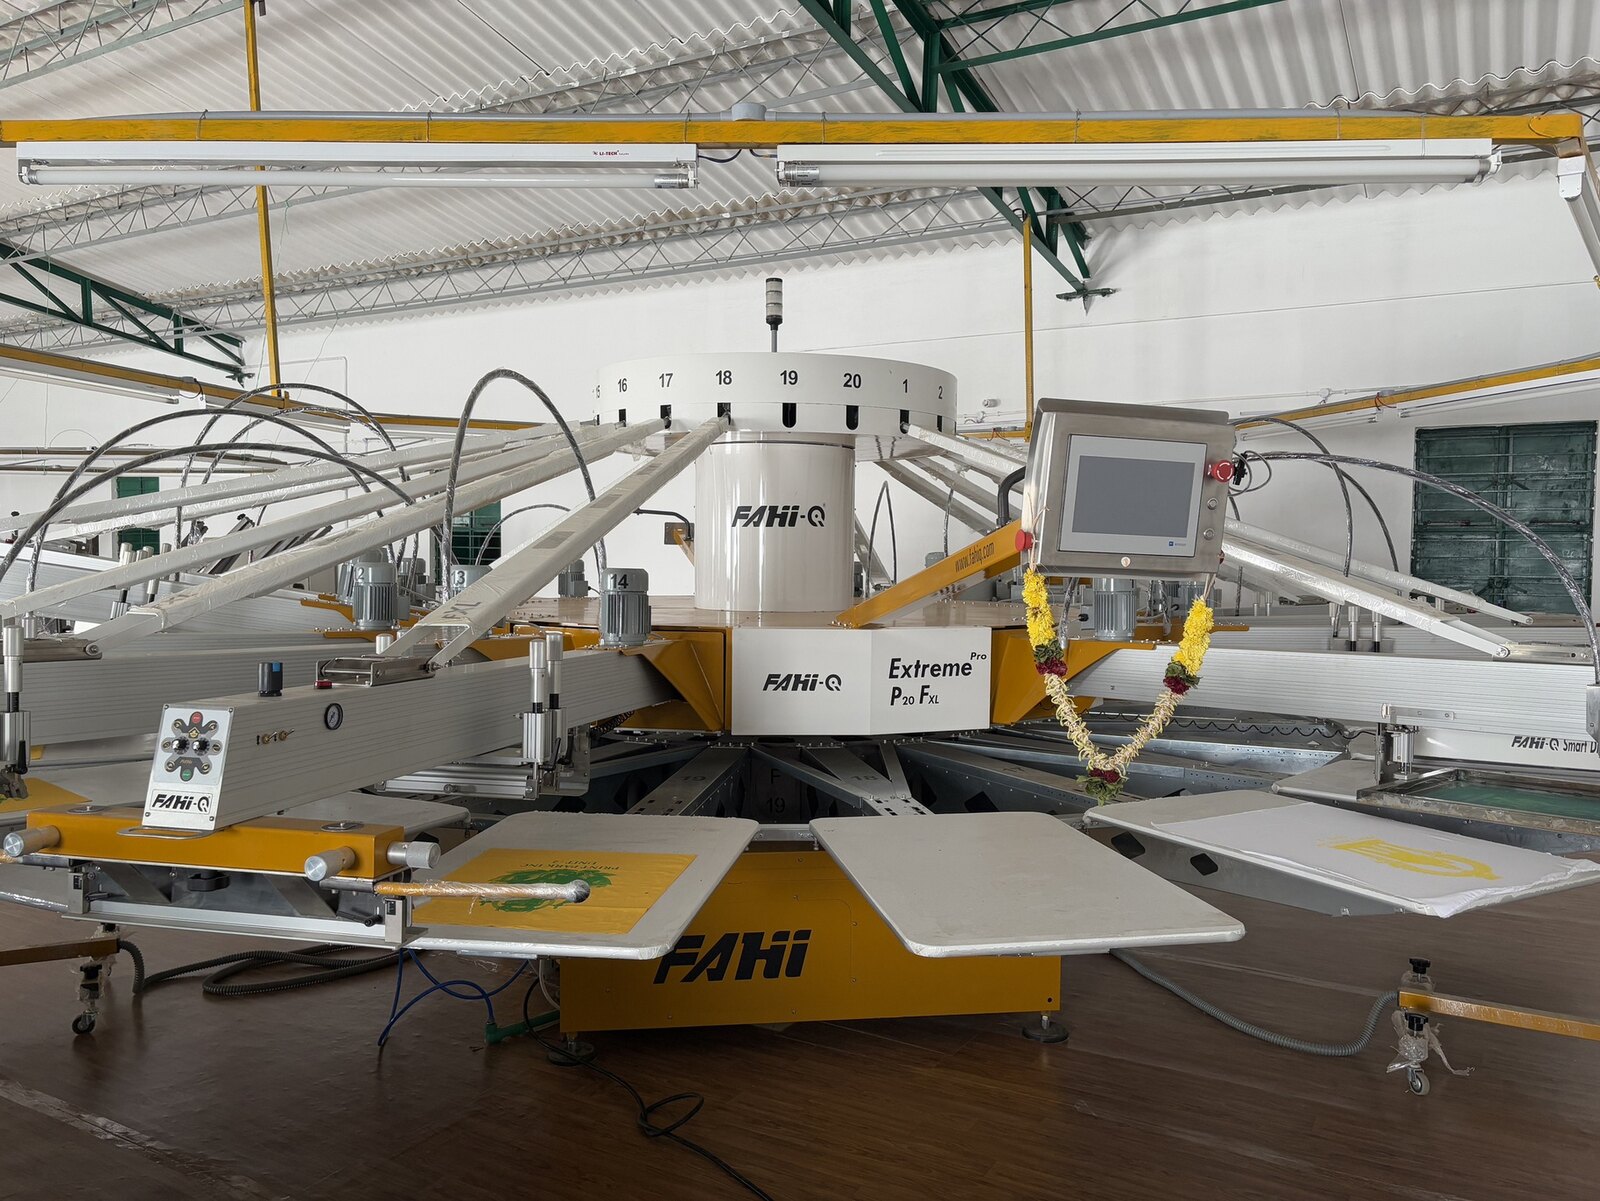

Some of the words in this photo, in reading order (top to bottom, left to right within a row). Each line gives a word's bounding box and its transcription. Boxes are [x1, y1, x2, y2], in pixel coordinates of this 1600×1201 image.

[617, 378, 628, 392] 16
[659, 373, 673, 388] 17
[715, 370, 732, 385] 18
[780, 370, 798, 385] 19
[843, 373, 861, 388] 20
[902, 379, 908, 394] 1
[938, 385, 943, 400] 2
[610, 573, 629, 589] 14
[888, 658, 973, 679] Extreme
[970, 652, 987, 661] Pro
[1563, 739, 1588, 753] Smart
[766, 797, 786, 813] 19
